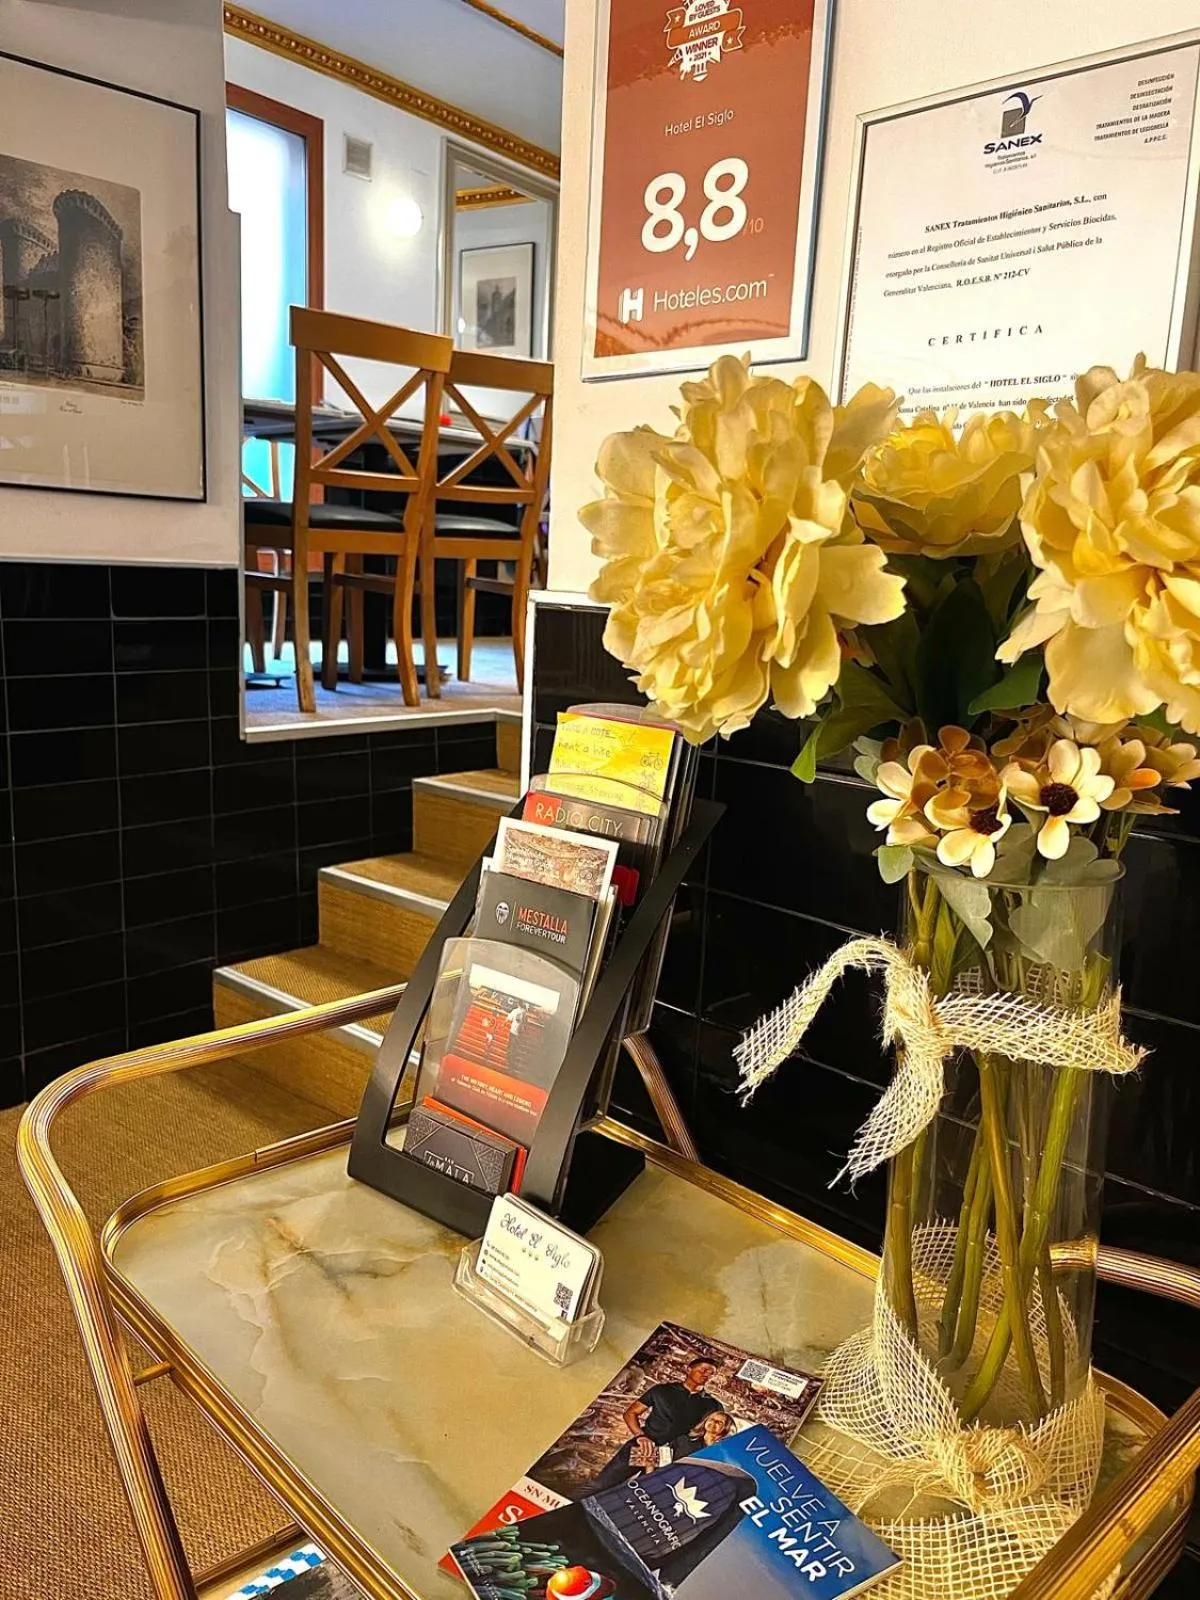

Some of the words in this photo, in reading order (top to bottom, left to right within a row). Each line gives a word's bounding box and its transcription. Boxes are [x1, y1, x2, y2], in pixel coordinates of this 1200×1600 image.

[688, 14, 697, 22] BY
[697, 5, 721, 18] GUESTS
[694, 0, 715, 12] LOVED
[688, 20, 721, 39] AWARD
[685, 36, 719, 55] WINNER
[664, 119, 692, 136] Hotel
[695, 114, 705, 129] El
[707, 109, 734, 126] Siglo
[1096, 117, 1133, 130] TRATAMIENTOS
[1149, 110, 1171, 120] MADERA
[983, 133, 1043, 154] SANEX
[1094, 129, 1131, 142] TRATAMIENTOS
[641, 156, 749, 262] 8,8
[924, 221, 951, 233] SANEX
[952, 213, 998, 228] Tratamientos
[1093, 193, 1107, 202] con
[926, 242, 953, 253] Registro
[953, 237, 976, 249] Oficial
[976, 236, 986, 244] de
[986, 225, 1041, 243] Establecimientos
[1048, 218, 1081, 231] Servicios
[912, 267, 923, 276] por
[924, 265, 931, 273] la
[967, 257, 976, 266] de
[976, 252, 999, 265] Sanitat
[1000, 247, 1032, 260] Universal
[1037, 243, 1055, 254] Salut
[1056, 239, 1083, 251] Pública
[1084, 238, 1094, 246] de
[1095, 236, 1103, 244] la
[653, 279, 768, 312] Hoteles.com
[883, 285, 917, 298] Generalitat
[1003, 267, 1031, 280] 212-CV
[908, 387, 921, 396] Que
[931, 383, 971, 393] instalaciones
[971, 380, 982, 389] del
[990, 377, 1020, 389] HOTEL
[1020, 377, 1032, 385] EL
[1033, 374, 1061, 385] SIGLO
[959, 402, 968, 410] de
[968, 399, 996, 409] Valencia
[998, 399, 1011, 407] han
[1012, 397, 1027, 407] sido
[535, 802, 584, 826] RADIO
[588, 815, 623, 836] CITY
[517, 906, 569, 935] MESTALLA
[500, 1212, 529, 1240] Hotel
[528, 1233, 543, 1249] El
[545, 1243, 571, 1269] Siglo
[745, 1437, 826, 1517] VUELVE
[817, 1520, 841, 1537] A
[738, 1496, 770, 1528] EL
[767, 1527, 827, 1582] MAR
[769, 1496, 855, 1578] SENTIR
